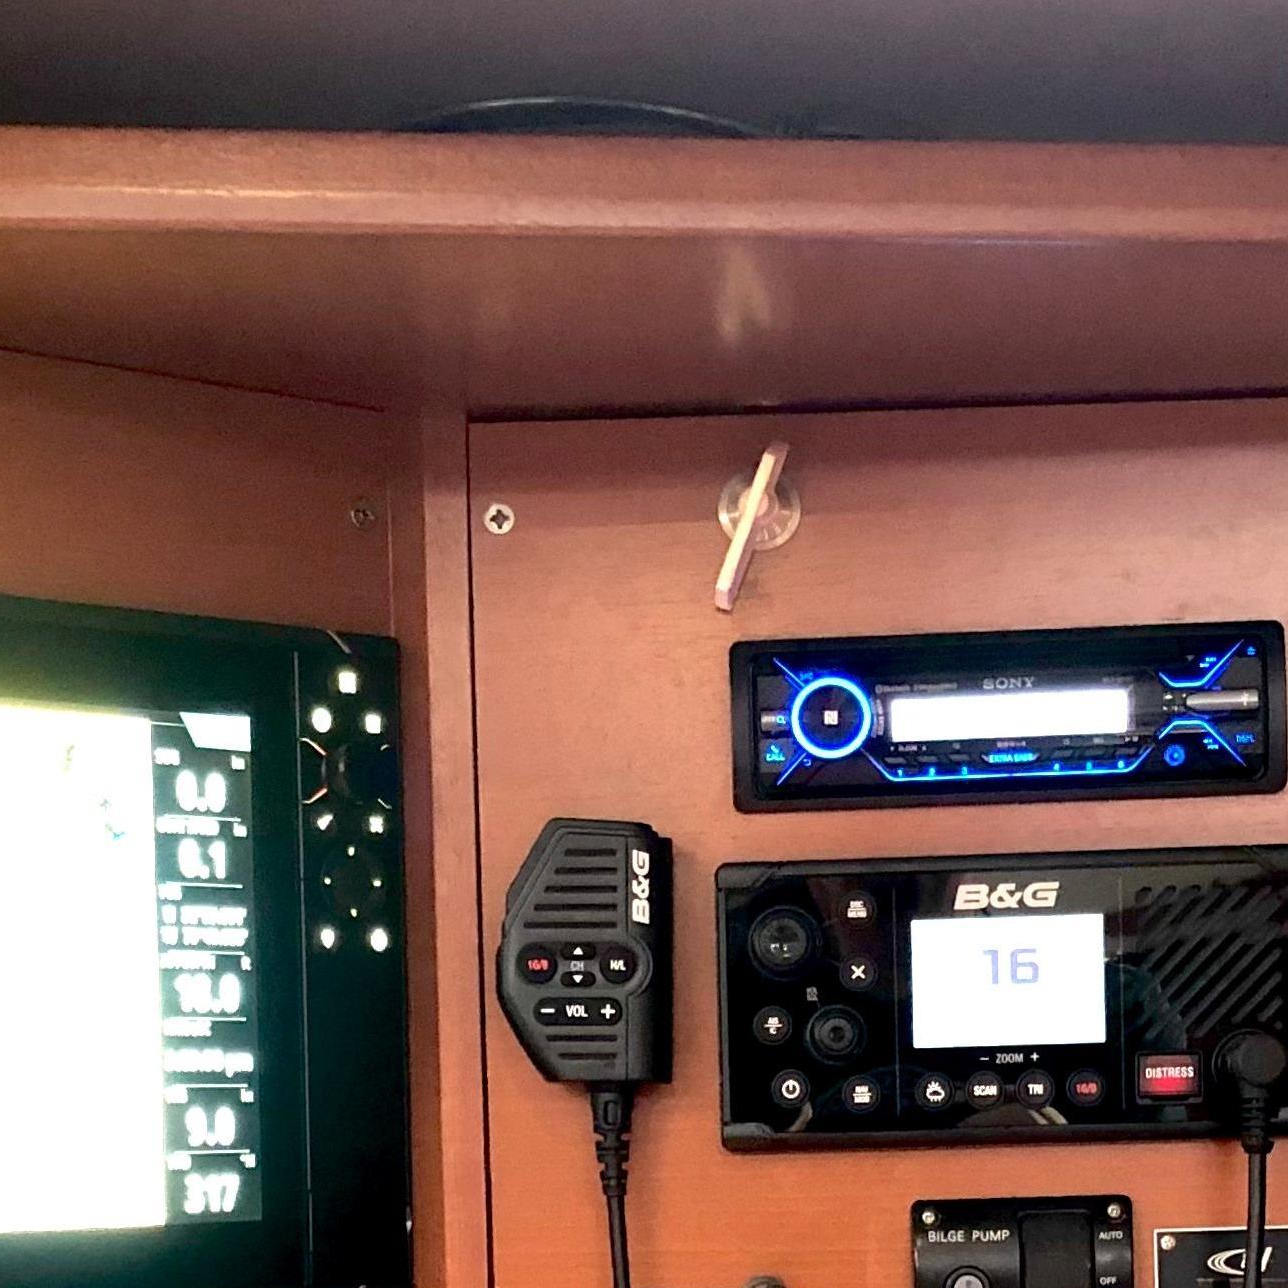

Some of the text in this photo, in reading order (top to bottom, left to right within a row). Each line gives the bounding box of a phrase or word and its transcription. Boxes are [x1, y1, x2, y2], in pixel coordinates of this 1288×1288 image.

[982, 677, 1035, 690] SONY
[631, 849, 650, 925] B&G
[954, 881, 1060, 911] B&G
[569, 956, 585, 971] CH
[982, 947, 1039, 986] 16
[565, 1004, 589, 1019] VOL
[995, 1053, 1024, 1064] ZOOM
[1145, 1067, 1194, 1079] DISTRESS
[973, 1084, 998, 1097] SCAN
[1028, 1083, 1043, 1095] TRI
[927, 1228, 1011, 1243] BILGE PUMP
[1098, 1229, 1123, 1241] AUTO
[1099, 1275, 1117, 1287] OFF
